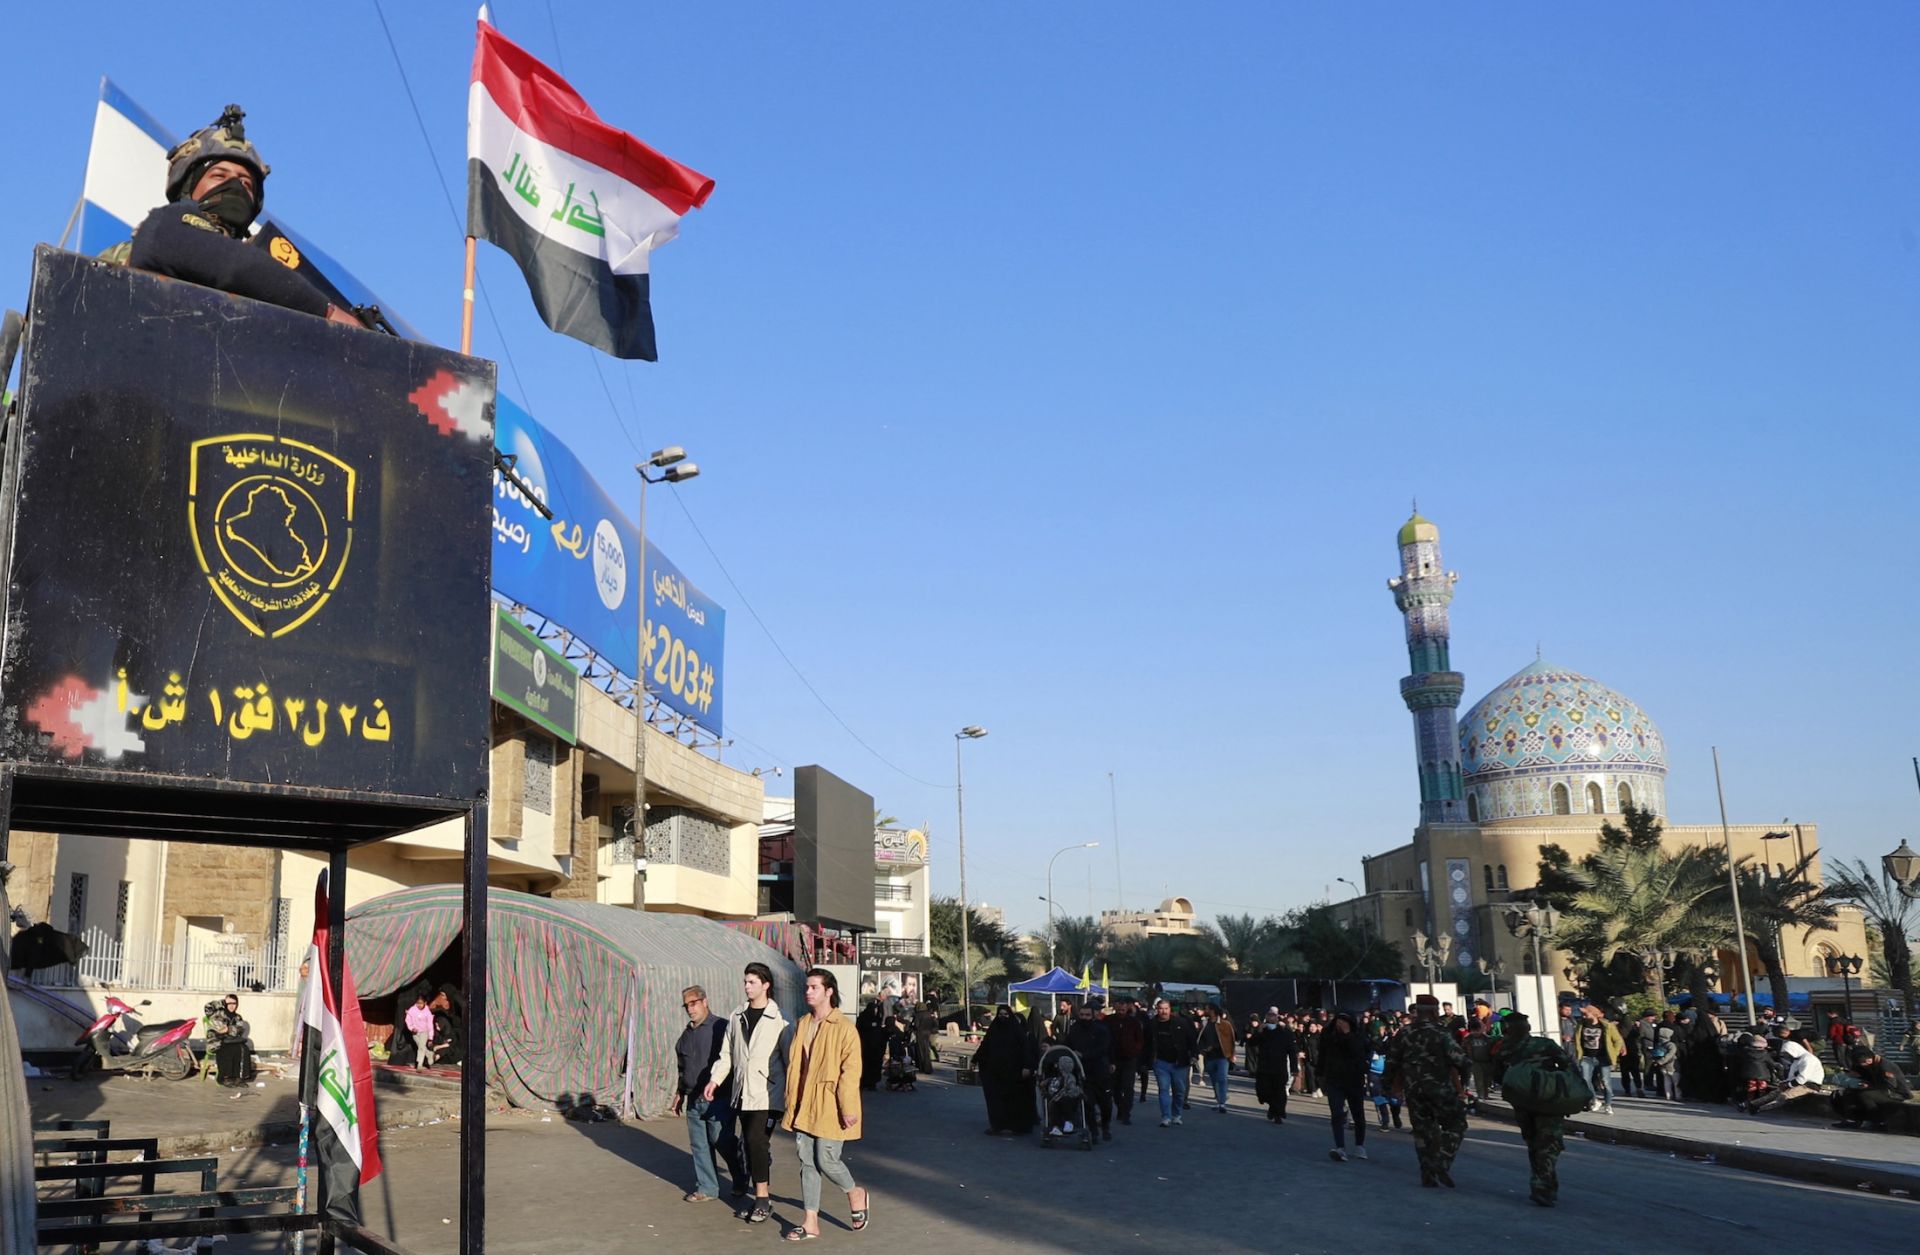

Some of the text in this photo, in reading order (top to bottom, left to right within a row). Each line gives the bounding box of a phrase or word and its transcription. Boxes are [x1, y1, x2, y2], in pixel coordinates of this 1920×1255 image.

[222, 445, 325, 486] وزارة الداخلية
[596, 532, 624, 569] 15,000
[653, 569, 705, 626] العرض الذهبي
